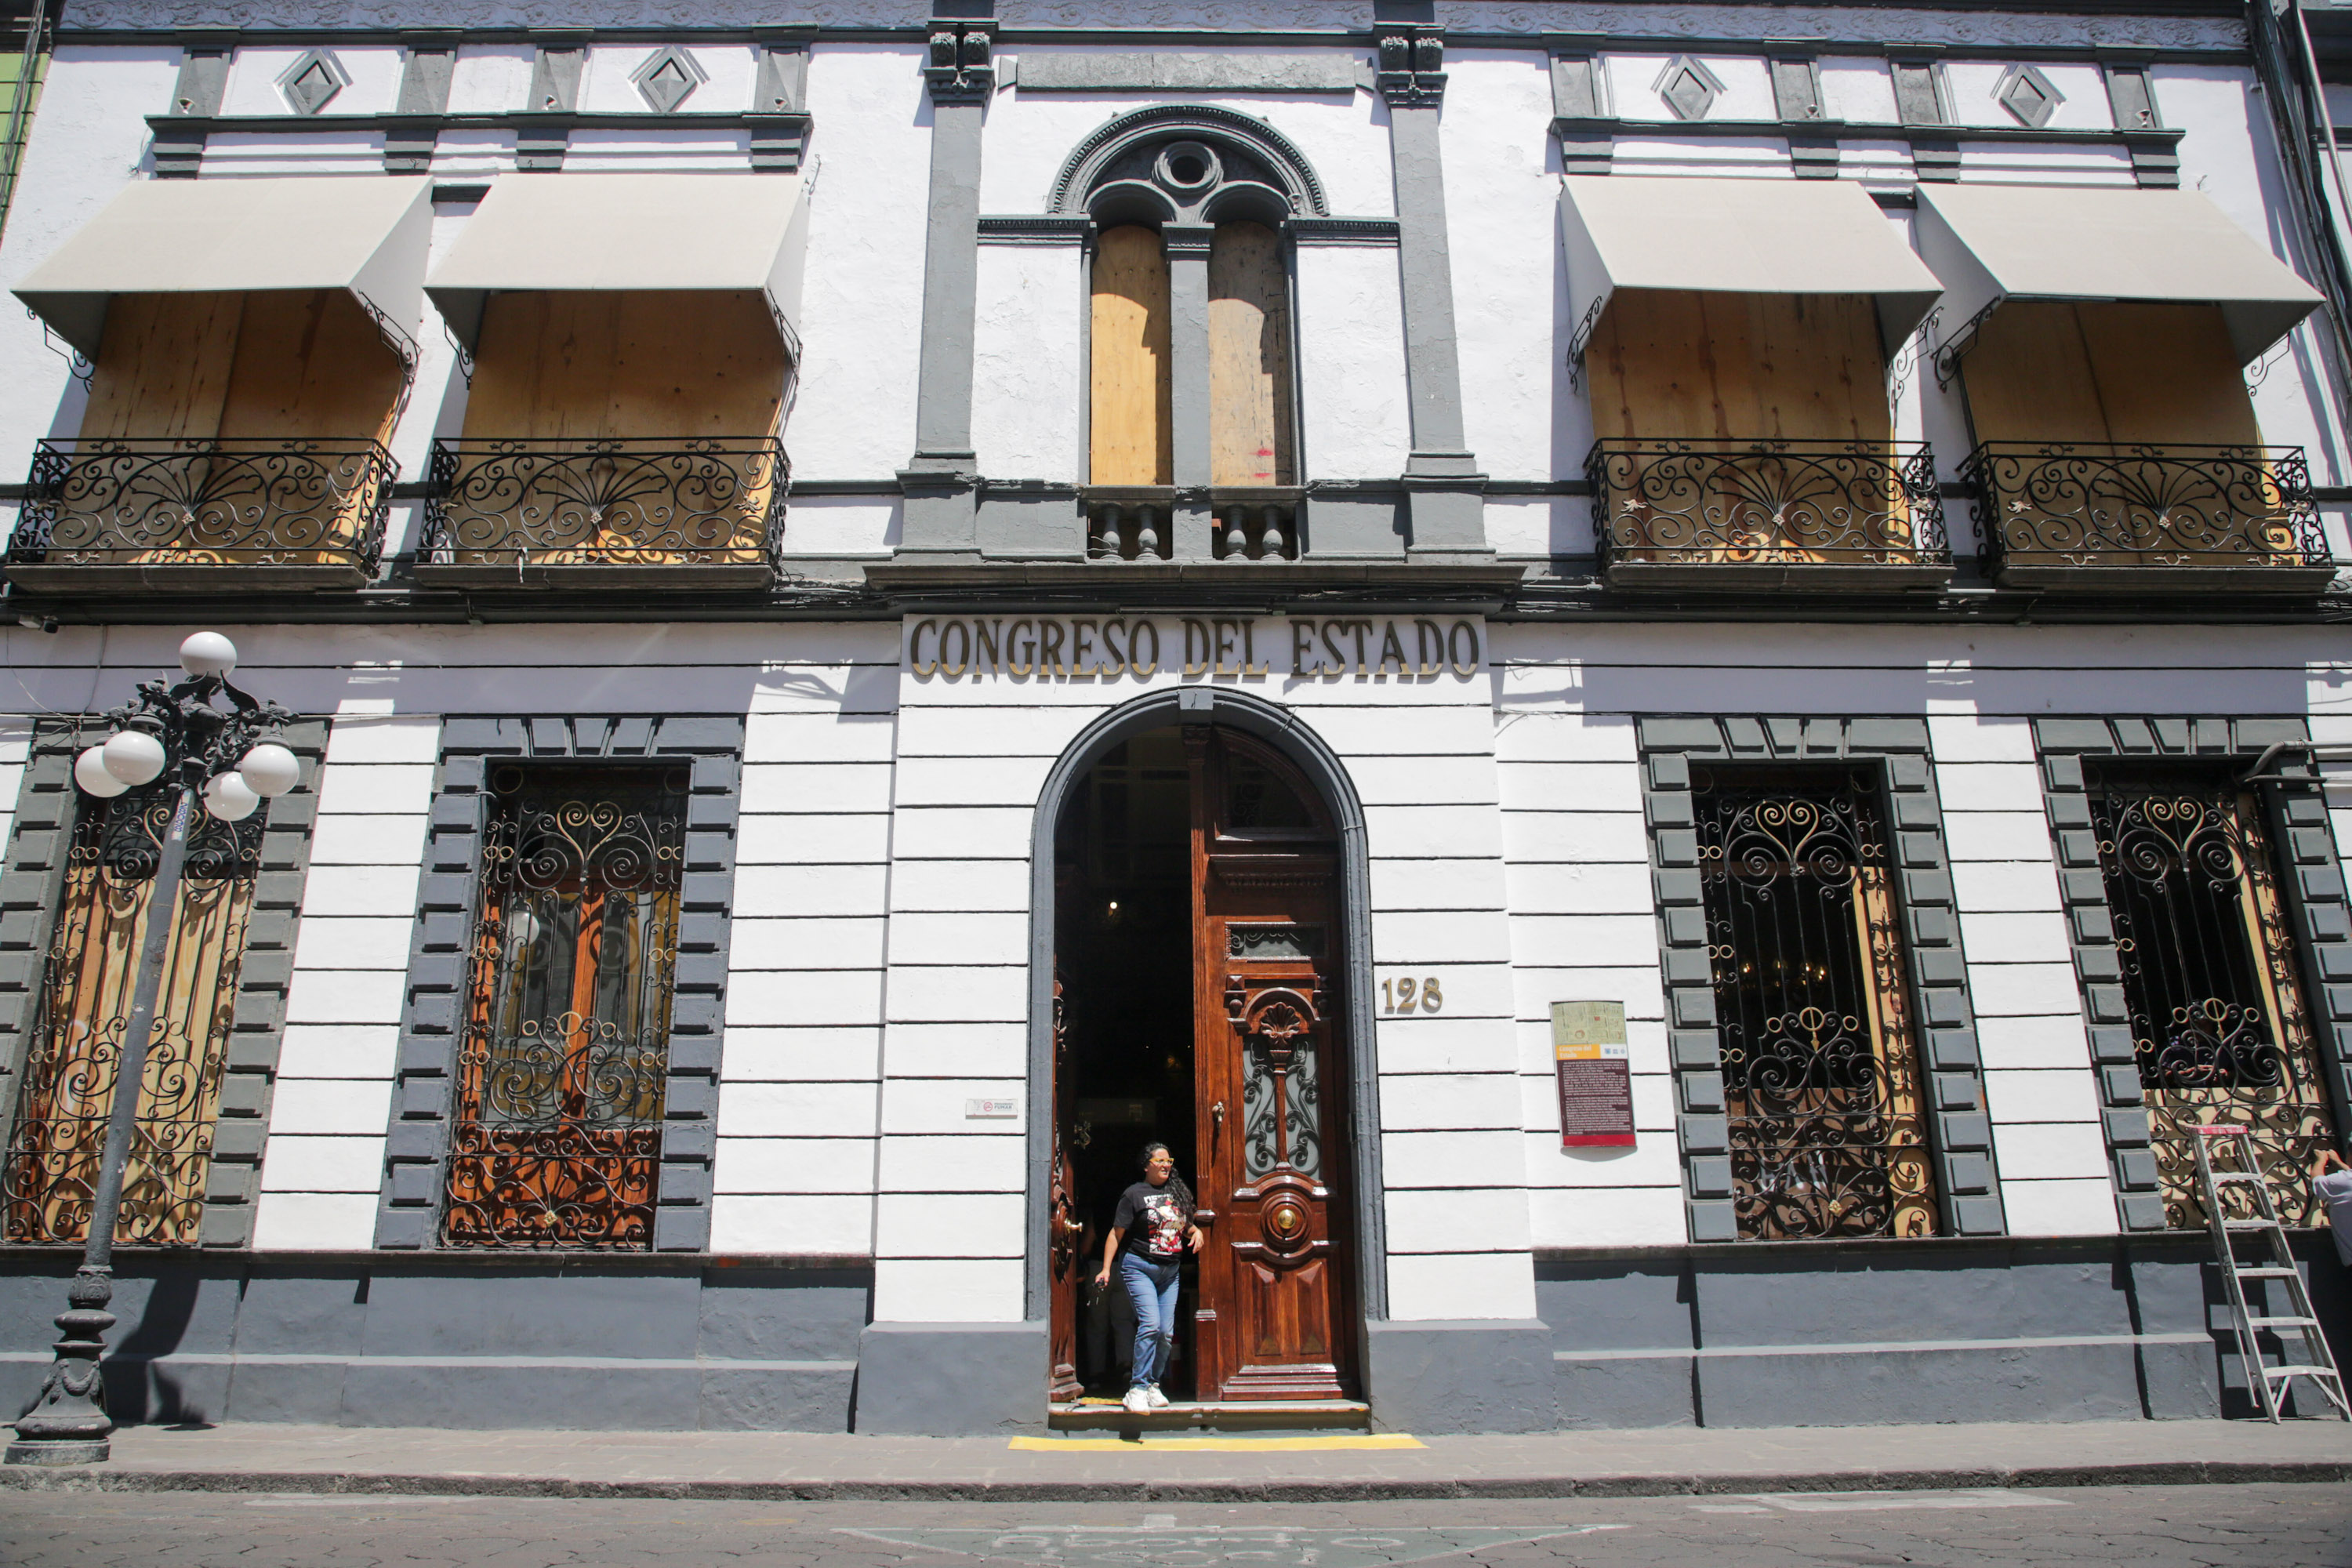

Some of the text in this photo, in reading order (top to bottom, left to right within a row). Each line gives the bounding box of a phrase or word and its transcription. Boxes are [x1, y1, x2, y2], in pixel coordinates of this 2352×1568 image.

[910, 619, 1479, 678] CONGRESO DEL ESTADO
[1381, 977, 1443, 1012] 128
